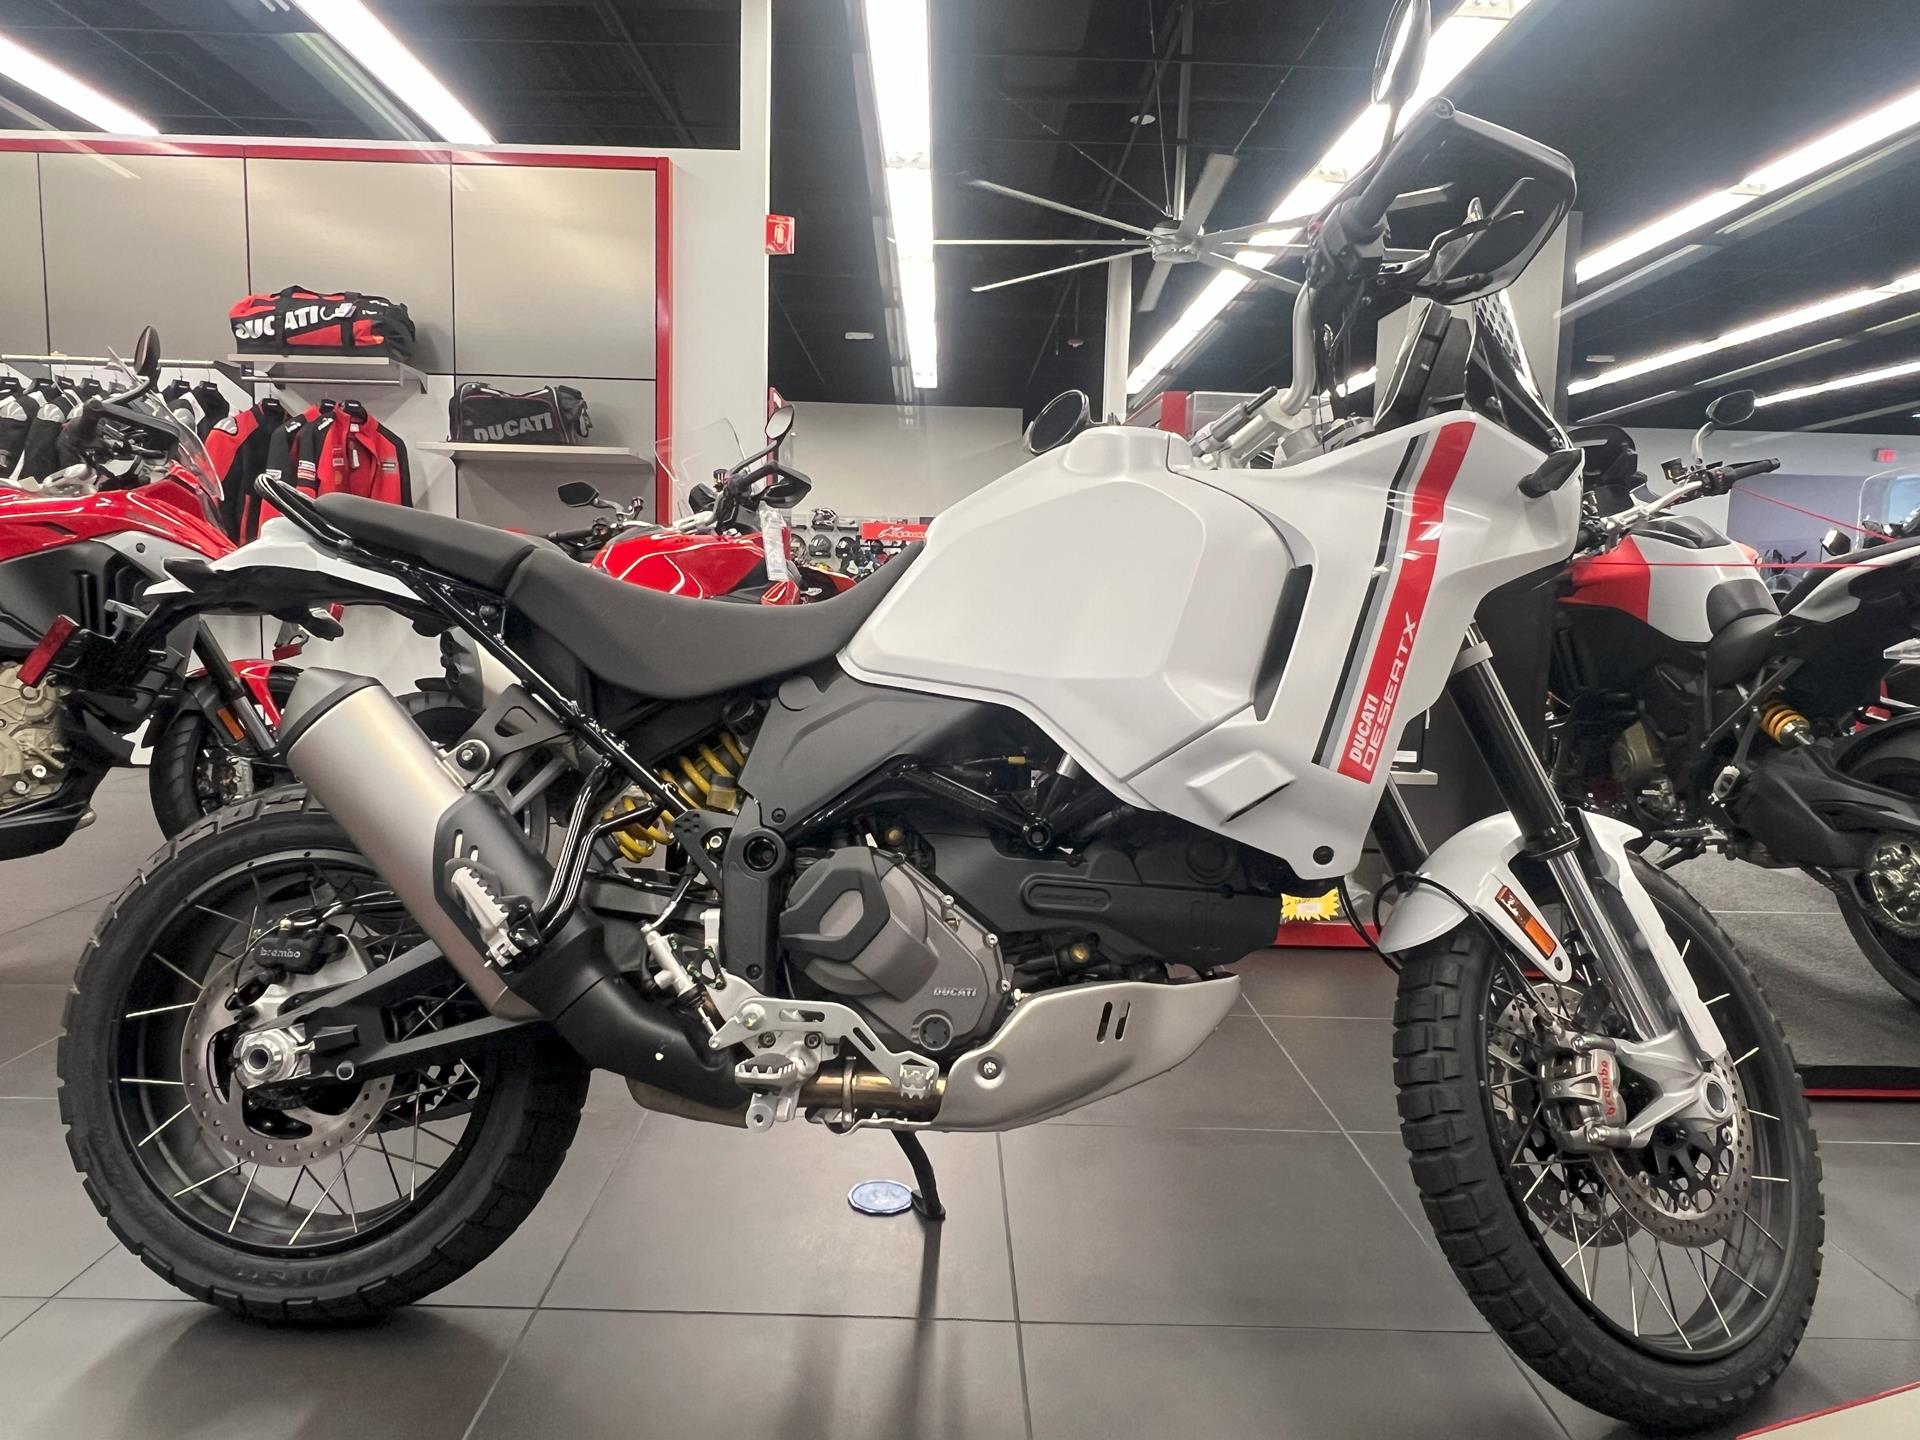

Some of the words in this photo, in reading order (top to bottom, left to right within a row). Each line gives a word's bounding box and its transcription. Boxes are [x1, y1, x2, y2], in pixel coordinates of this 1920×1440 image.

[473, 412, 553, 442] DUCATI
[1361, 611, 1417, 772] DESERTX
[1349, 693, 1379, 765] DUCATI
[260, 946, 301, 959] brembo
[933, 987, 977, 997] DUCATI
[1600, 1060, 1617, 1116] brembo
